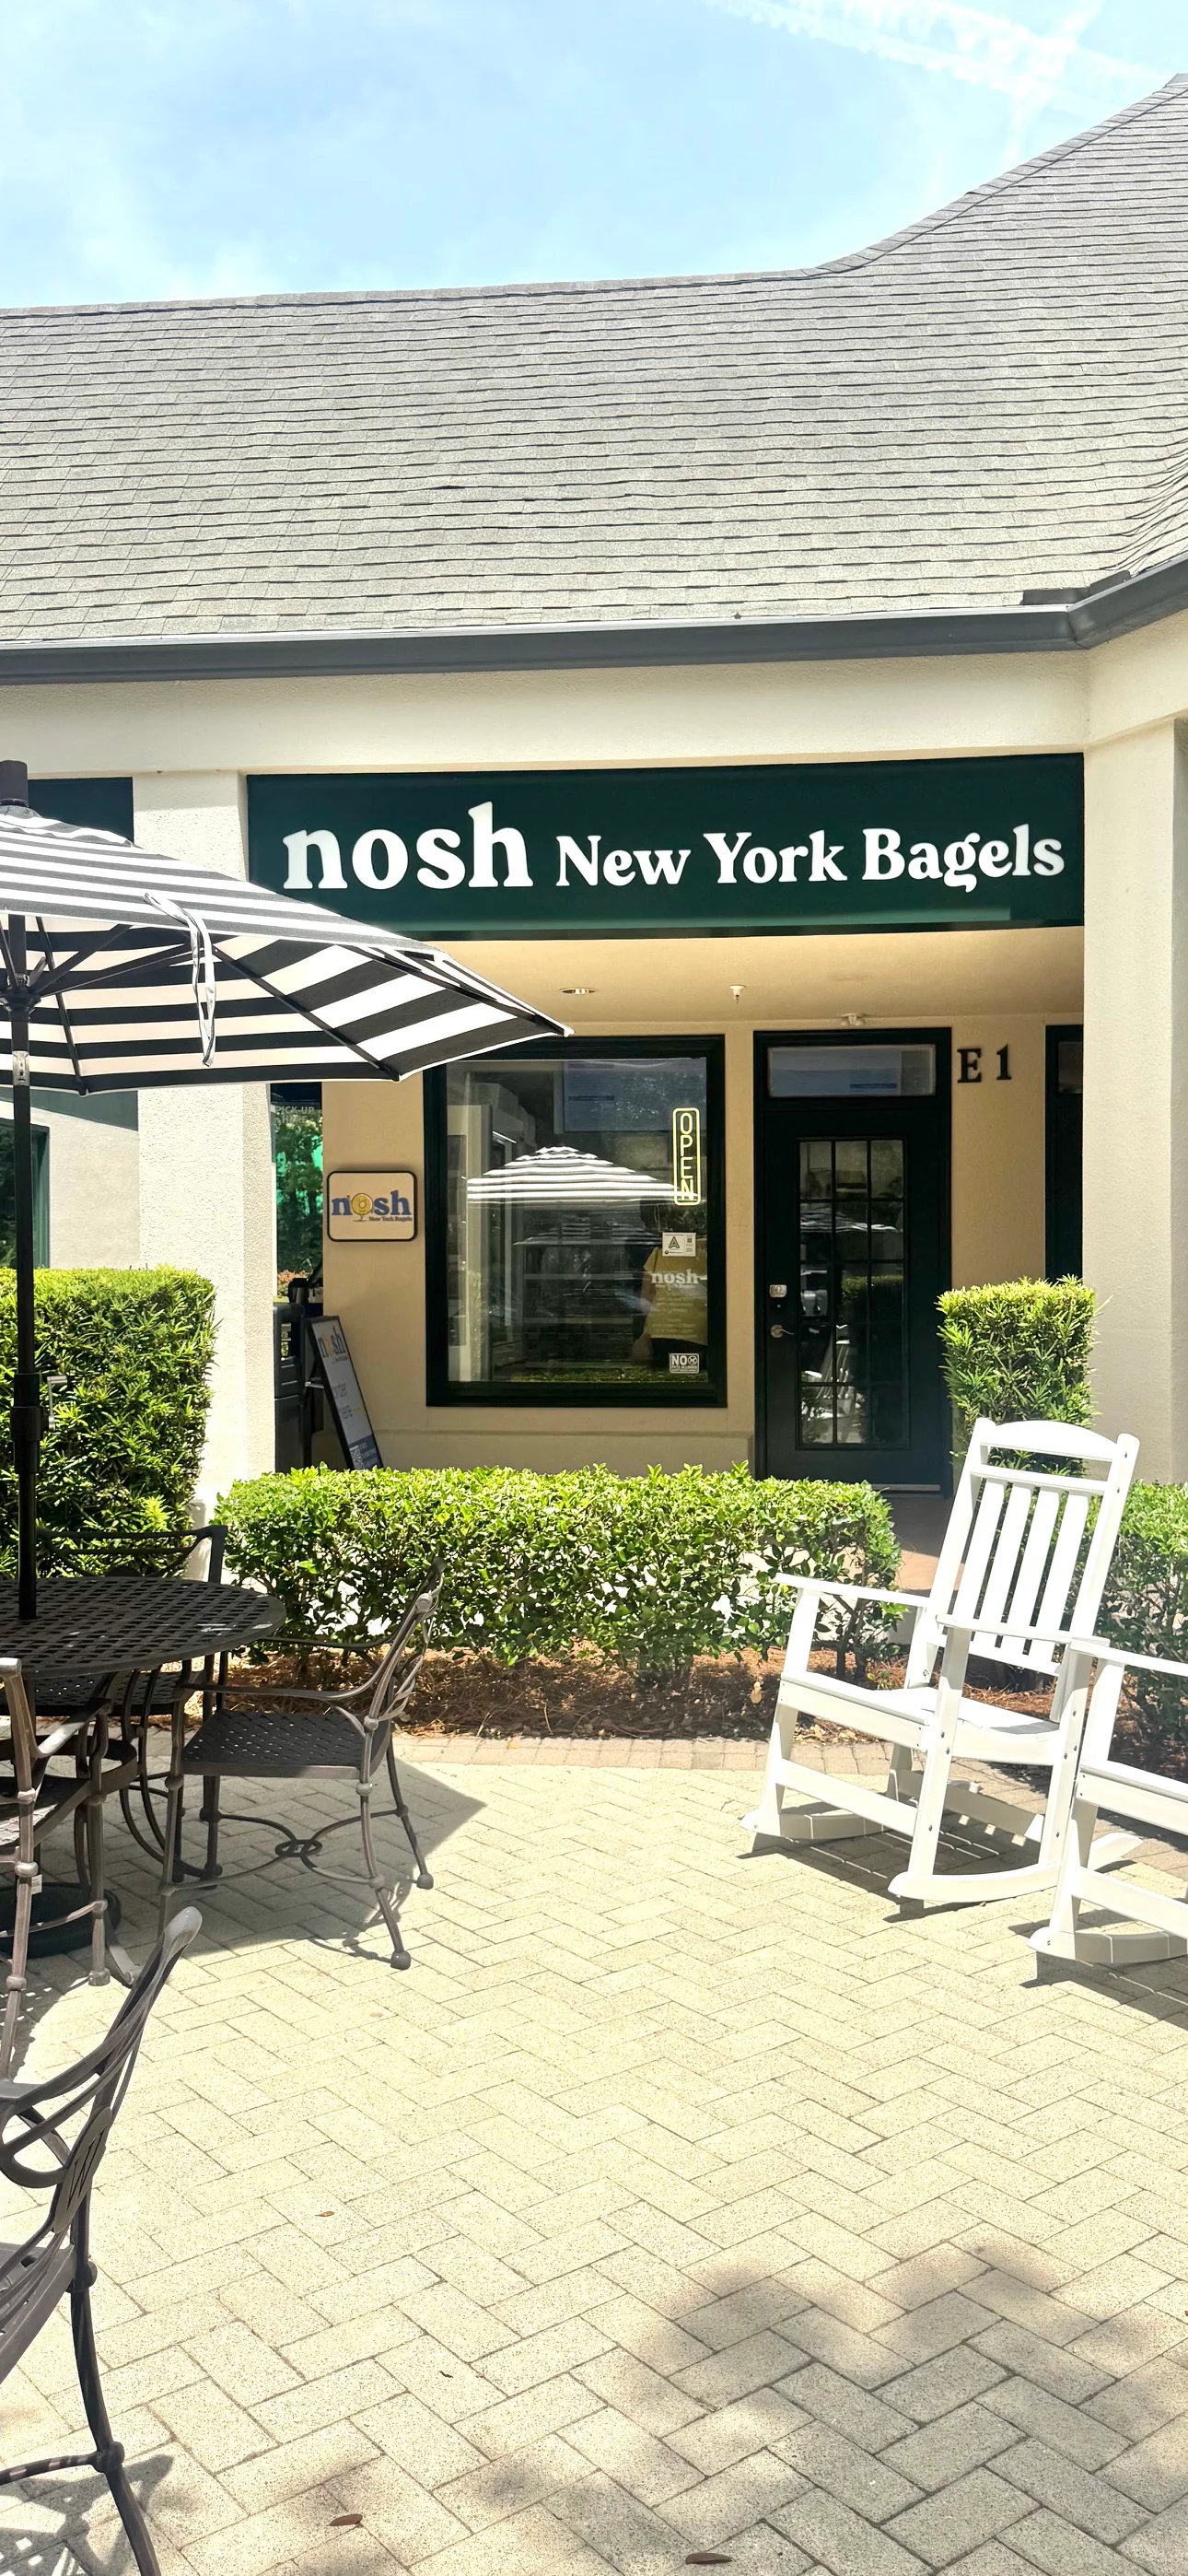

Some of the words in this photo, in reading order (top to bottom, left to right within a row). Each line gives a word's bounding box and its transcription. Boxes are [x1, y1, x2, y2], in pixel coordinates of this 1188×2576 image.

[282, 801, 534, 890] nosh
[554, 834, 692, 886] New
[703, 829, 849, 884] York
[862, 823, 1066, 893] Bagels
[275, 1106, 315, 1115] PICK-UP
[680, 1111, 694, 1201] OPEN
[331, 1189, 413, 1216] nosh
[668, 1235, 681, 1249] A
[650, 1268, 700, 1284] nosh
[671, 1354, 688, 1365] NO
